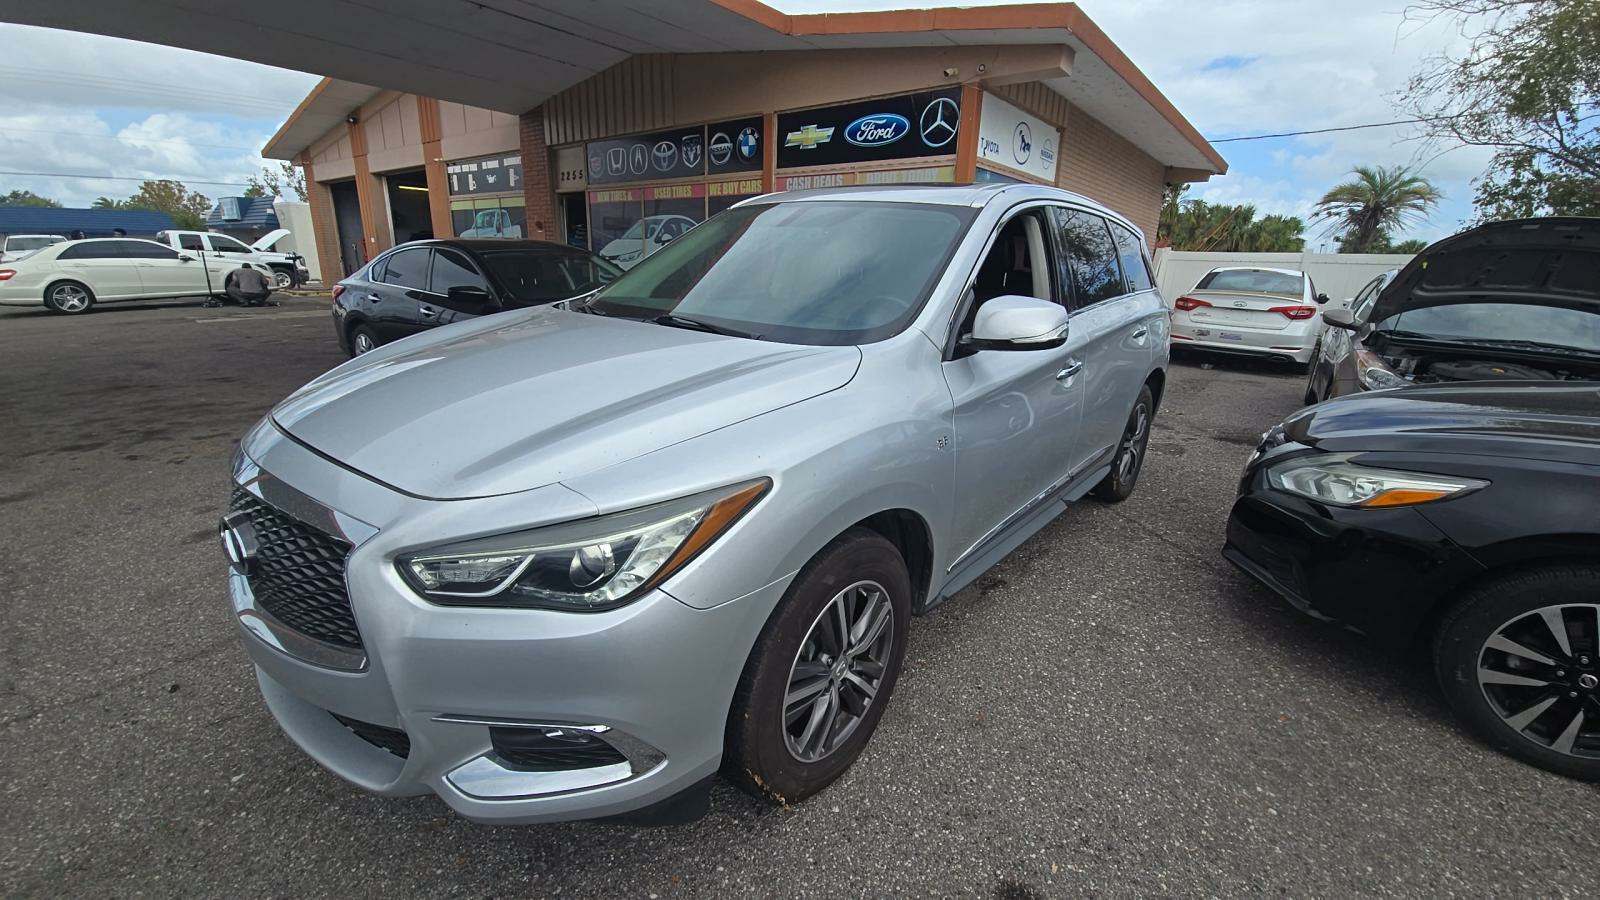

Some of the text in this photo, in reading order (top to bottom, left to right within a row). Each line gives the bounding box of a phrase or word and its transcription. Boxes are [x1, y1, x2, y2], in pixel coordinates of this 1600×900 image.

[857, 119, 896, 141] Ford
[561, 170, 583, 181] 2255
[786, 174, 843, 191] CASH DEALS
[672, 185, 692, 198] TIRES
[709, 179, 762, 195] WE BUY CARS
